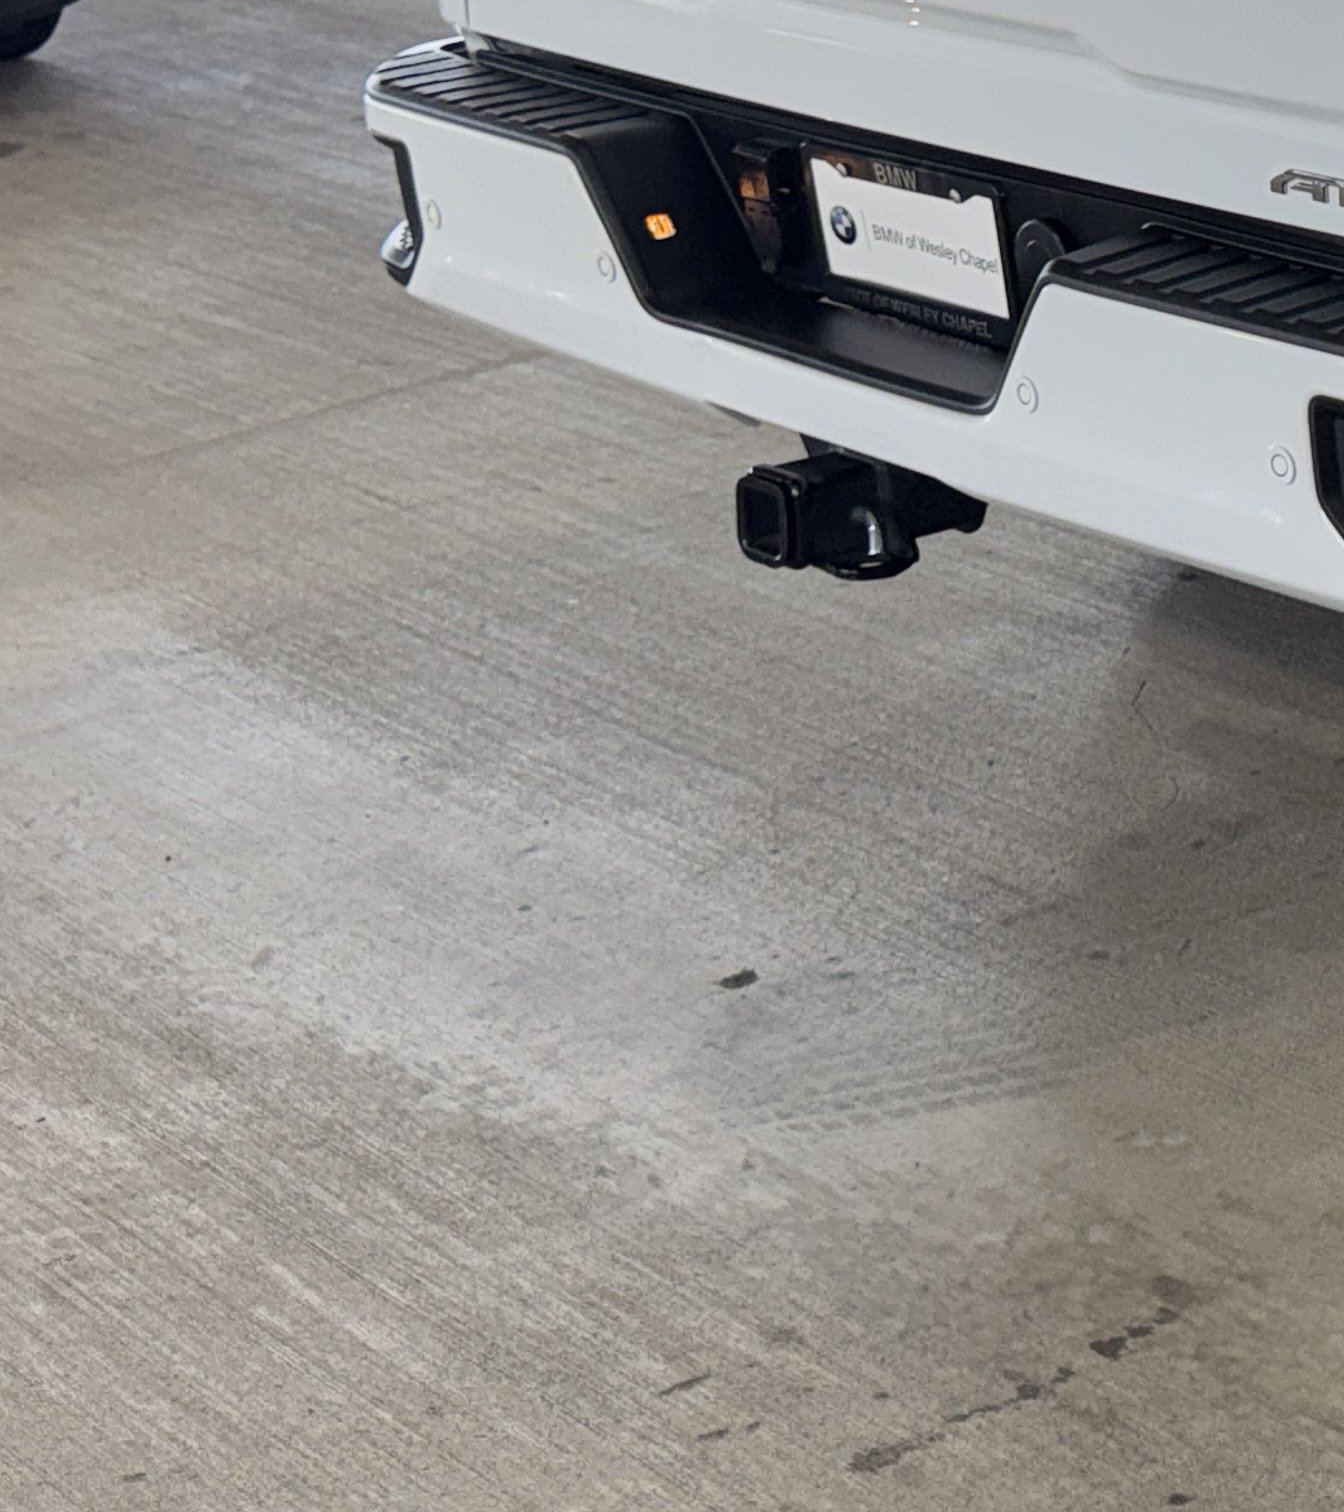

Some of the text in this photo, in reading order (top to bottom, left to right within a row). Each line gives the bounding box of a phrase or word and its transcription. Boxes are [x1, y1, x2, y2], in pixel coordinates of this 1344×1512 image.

[873, 163, 918, 191] BMW
[872, 224, 1000, 275] BMW of Wesley Chapel
[941, 311, 993, 339] CHAPEL
